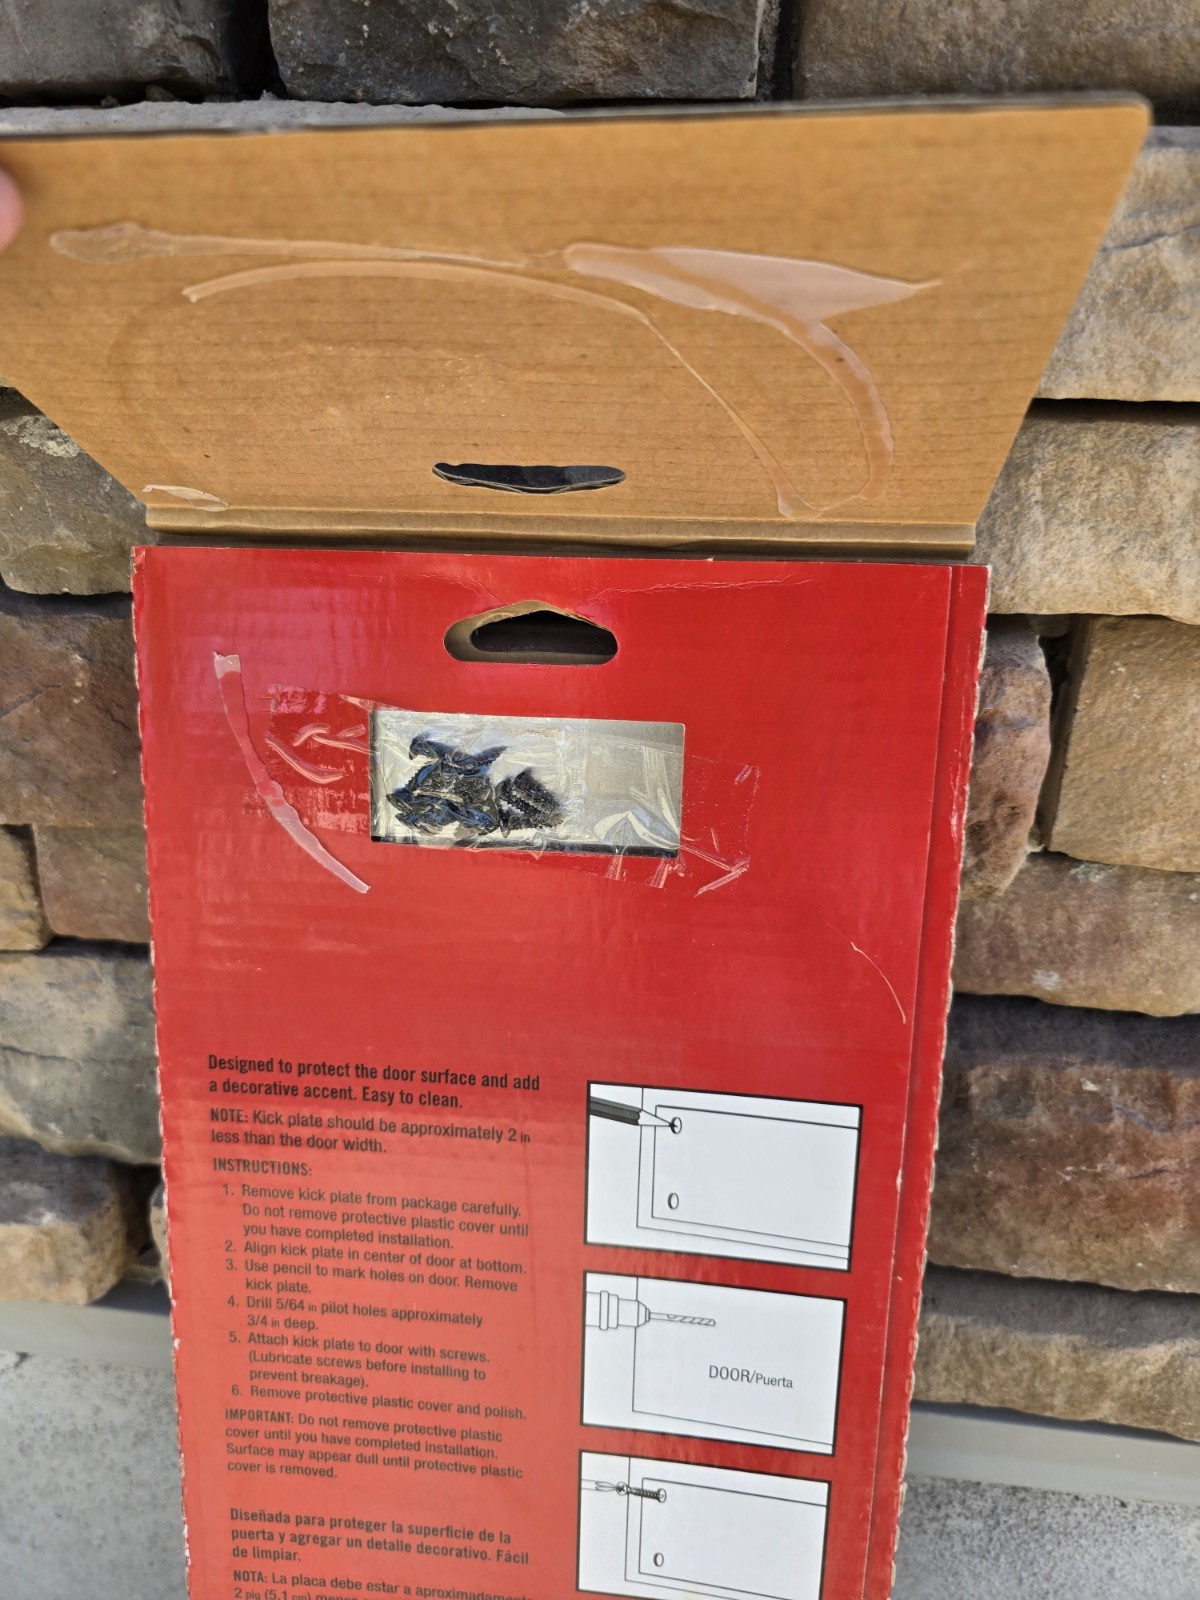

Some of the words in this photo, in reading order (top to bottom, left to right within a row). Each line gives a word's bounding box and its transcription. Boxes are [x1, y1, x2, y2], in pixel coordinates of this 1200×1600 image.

[209, 1054, 274, 1074] Designed
[278, 1059, 292, 1074] to
[298, 1061, 350, 1078] protect
[355, 1063, 378, 1079] the
[383, 1066, 415, 1082] door
[421, 1068, 476, 1086] surface
[481, 1073, 508, 1088] and
[513, 1075, 540, 1090] add
[209, 1081, 217, 1092] a
[223, 1079, 299, 1097] decorative
[304, 1086, 357, 1100] accent.
[363, 1087, 394, 1105] Easy
[400, 1090, 414, 1104] to
[419, 1091, 462, 1108] clean.
[210, 1108, 248, 1123] NOTE:
[253, 1111, 283, 1125] Kick
[288, 1113, 323, 1128] plate
[327, 1116, 374, 1131] should
[379, 1119, 396, 1133] be
[401, 1121, 503, 1143] approximately
[507, 1128, 517, 1141] 2
[521, 1132, 530, 1143] in
[211, 1130, 239, 1143] less
[244, 1131, 275, 1145] than
[280, 1133, 302, 1146] the
[307, 1135, 338, 1149] door
[343, 1138, 387, 1152] width.
[213, 1158, 312, 1176] INSTRUCTIONS:
[222, 1184, 234, 1196] 1.
[242, 1185, 294, 1199] Remove
[299, 1188, 325, 1201] kick
[330, 1190, 362, 1205] plate
[366, 1193, 396, 1206] from
[402, 1196, 457, 1213] package
[461, 1199, 520, 1218] carefully.
[243, 1204, 259, 1216] Do
[264, 1205, 285, 1217] not
[289, 1209, 337, 1221] remove
[342, 1211, 407, 1226] protective
[411, 1215, 454, 1231] plastic
[459, 1220, 495, 1233] cover
[500, 1222, 528, 1236] until
[244, 1225, 266, 1237] you
[271, 1224, 301, 1238] have
[306, 1227, 374, 1245] completed
[378, 1233, 453, 1249] installation.
[225, 1240, 236, 1252] 2.
[244, 1241, 276, 1256] Align
[281, 1243, 307, 1256] kick
[312, 1245, 343, 1260] plate
[348, 1247, 359, 1260] in
[364, 1249, 405, 1263] center
[409, 1253, 422, 1265] of
[426, 1253, 455, 1267] door
[459, 1257, 472, 1269] at
[476, 1258, 526, 1274] bottom.
[226, 1259, 237, 1271] 3.
[245, 1260, 268, 1272] Use
[273, 1262, 311, 1277] pencil
[315, 1265, 328, 1276] to
[333, 1265, 365, 1279] mark
[370, 1268, 404, 1282] holes
[409, 1272, 424, 1283] on
[429, 1272, 459, 1286] door.
[465, 1276, 517, 1292] Remove
[246, 1279, 272, 1291] kick
[277, 1281, 311, 1296] plate.
[228, 1295, 238, 1307] 4.
[247, 1296, 272, 1309] Drill
[276, 1298, 305, 1310] 5/64
[309, 1302, 317, 1312] in
[321, 1301, 348, 1317] pilot
[353, 1304, 387, 1317] holes
[392, 1308, 483, 1327] approximately
[247, 1314, 267, 1327] 3/4
[272, 1319, 280, 1328] in
[284, 1317, 318, 1332] deep.
[229, 1331, 240, 1343] 5.
[248, 1332, 289, 1346] Attach
[293, 1334, 318, 1347] kick
[323, 1337, 355, 1351] plate
[359, 1340, 371, 1351] to
[375, 1341, 403, 1354] door
[408, 1345, 435, 1358] with
[440, 1348, 490, 1362] screws.
[249, 1350, 312, 1365] (Lubricate
[317, 1356, 362, 1368] screws
[366, 1359, 407, 1372] before
[411, 1362, 469, 1381] installing
[473, 1368, 486, 1380] to
[250, 1369, 297, 1383] prevent
[302, 1371, 368, 1389] breakage).
[709, 1365, 793, 1388] DOOR/Puerta
[232, 1385, 243, 1396] 6.
[250, 1386, 301, 1399] Remove
[305, 1390, 367, 1406] protective
[372, 1394, 413, 1410] plastic
[418, 1399, 452, 1412] cover
[457, 1402, 480, 1416] and
[484, 1405, 526, 1421] polish.
[225, 1408, 294, 1424] IMPORTANT:
[298, 1413, 314, 1425] Do
[319, 1415, 338, 1427] not
[343, 1418, 389, 1431] remove
[394, 1421, 456, 1438] protective
[461, 1427, 503, 1443] plastic
[226, 1425, 260, 1438] cover
[264, 1427, 291, 1441] until
[295, 1432, 317, 1445] you
[322, 1431, 350, 1445] have
[355, 1434, 421, 1453] completed
[425, 1441, 498, 1459] installation.
[226, 1443, 274, 1457] Surface
[279, 1447, 304, 1461] may
[309, 1450, 351, 1465] appear
[356, 1451, 378, 1465] dull
[383, 1454, 410, 1468] until
[414, 1458, 476, 1475] protective
[481, 1464, 522, 1480] plastic
[228, 1460, 261, 1472] cover
[266, 1462, 276, 1473] is
[280, 1464, 337, 1478] removed.
[230, 1508, 290, 1524] Diseñada
[295, 1514, 325, 1528] para
[330, 1516, 387, 1532] proteger
[392, 1520, 403, 1534] la
[408, 1523, 474, 1540] superficie
[479, 1529, 494, 1542] de
[500, 1531, 511, 1544] la
[232, 1528, 274, 1542] puerta
[278, 1532, 285, 1544] y
[290, 1532, 341, 1547] agregar
[346, 1537, 362, 1548] un
[367, 1537, 411, 1553] detalle
[417, 1541, 491, 1561] decorativo.
[496, 1550, 528, 1565] Fácil
[232, 1546, 248, 1558] de
[253, 1547, 301, 1563] limpiar.
[234, 1570, 267, 1583] NOTA:
[272, 1573, 287, 1585] La
[292, 1575, 326, 1589] placa
[331, 1577, 362, 1591] debe
[367, 1581, 399, 1594] estar
[404, 1584, 411, 1595] a
[235, 1587, 242, 1599] 2
